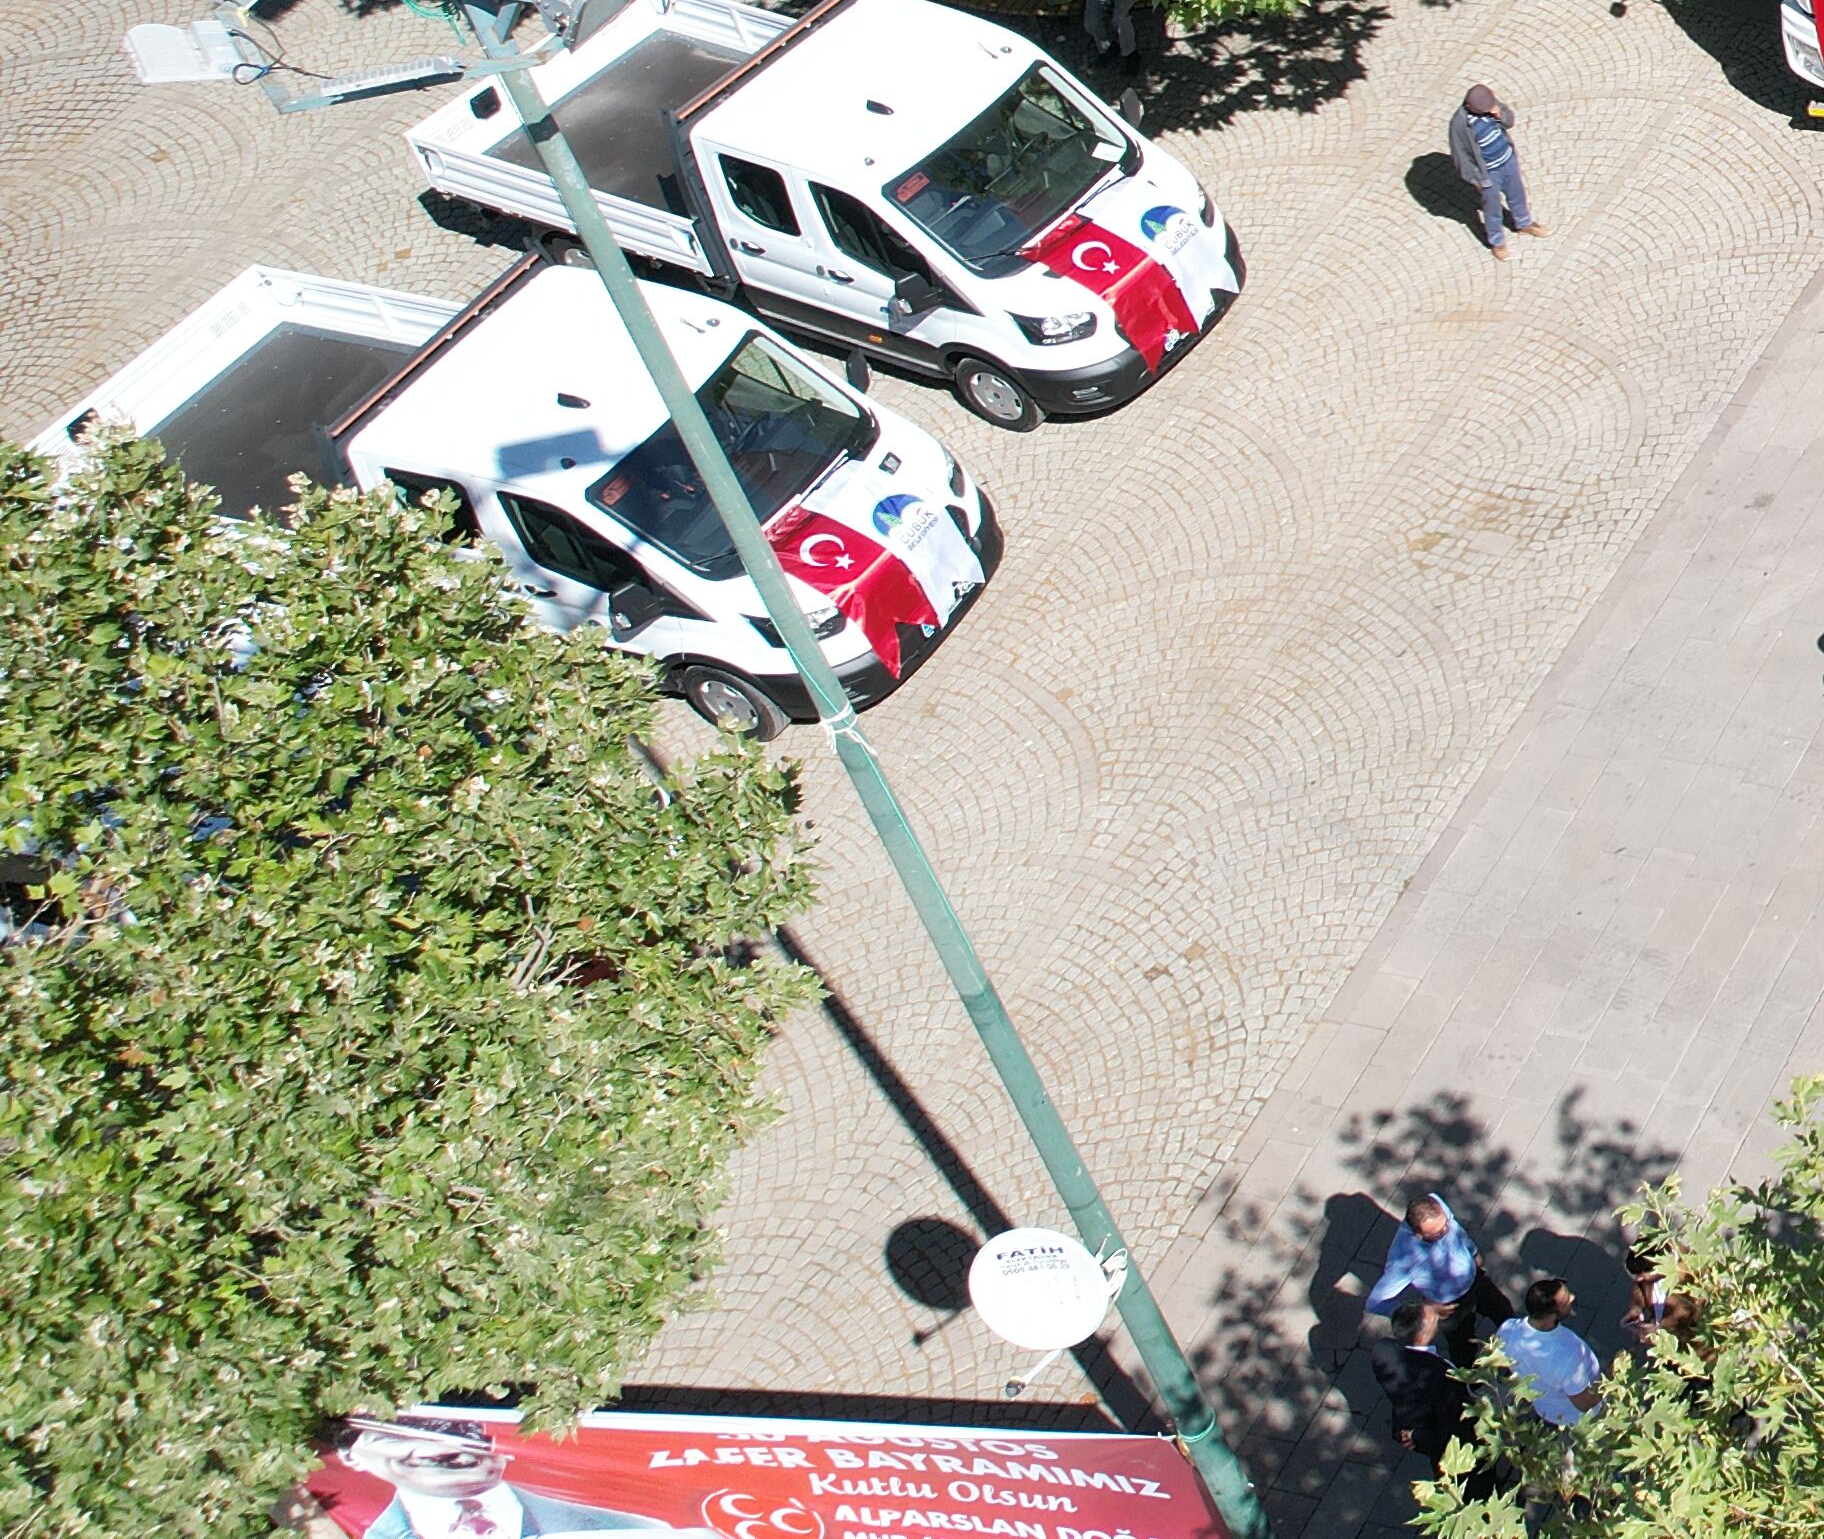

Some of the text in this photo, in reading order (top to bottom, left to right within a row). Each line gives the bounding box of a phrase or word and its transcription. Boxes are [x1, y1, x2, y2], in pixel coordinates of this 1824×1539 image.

[808, 1472, 1079, 1513] Kutlu Olsun
[824, 1447, 1172, 1500] BAYRAMIMIZ
[834, 1504, 1047, 1539] ALPARSLAN
